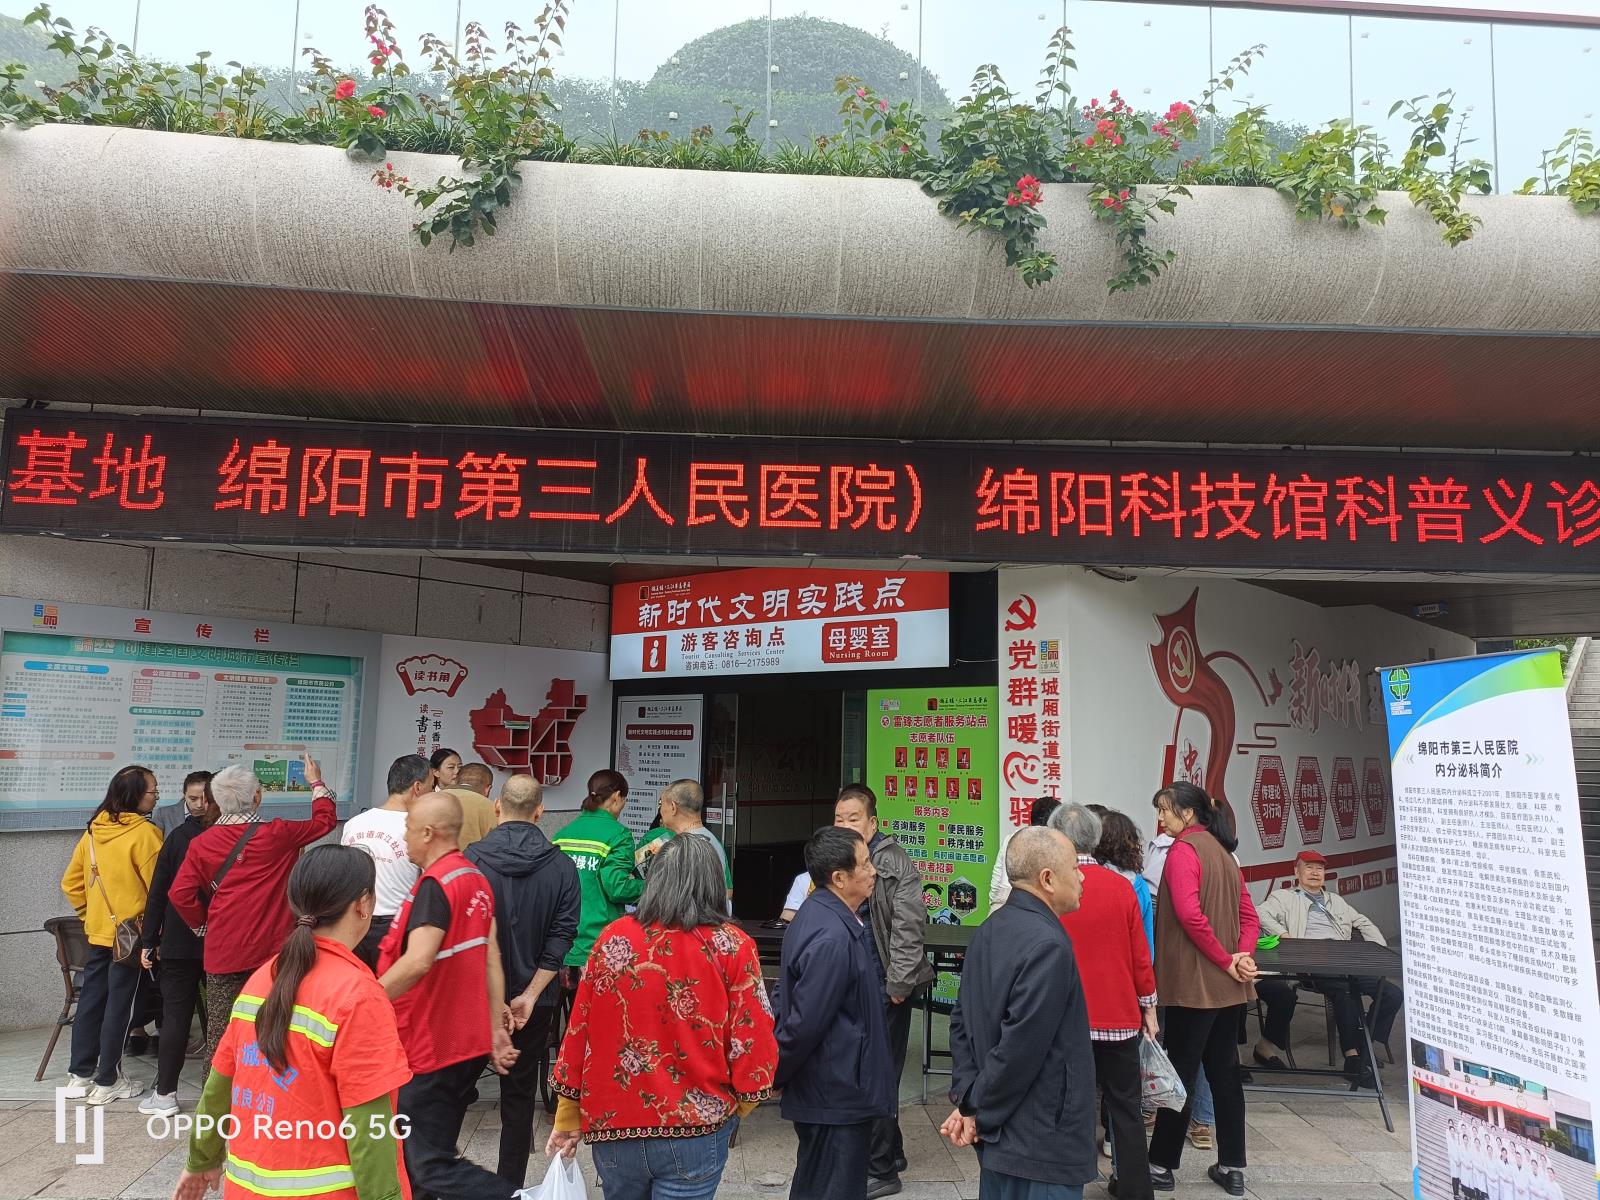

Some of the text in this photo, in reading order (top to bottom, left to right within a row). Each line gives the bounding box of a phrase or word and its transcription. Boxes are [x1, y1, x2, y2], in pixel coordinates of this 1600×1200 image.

[8, 429, 166, 511] 基地
[976, 467, 1600, 547] 绵阳科技馆科普义诊
[638, 577, 907, 629] 新时代文明实践点
[681, 626, 786, 652] 游客咨询点
[829, 624, 890, 651] 母婴室
[704, 651, 734, 659] Consulting
[765, 648, 785, 656] Center
[829, 649, 889, 660] Nursing Room
[414, 670, 450, 683] 读书角
[893, 715, 988, 728] 雷锋志愿者服务站点
[910, 733, 955, 744] 志愿者队伍
[1418, 740, 1520, 756] 绵阳市第三人民医院
[1435, 762, 1503, 779] 内分泌科简介
[1261, 783, 1281, 800] 传理论
[914, 806, 950, 818] 服务内容
[1262, 802, 1282, 818] 习行动
[1302, 801, 1320, 816] 习发展
[892, 820, 984, 837] 咨询服务 便民服务
[947, 838, 984, 850] 秩序维护
